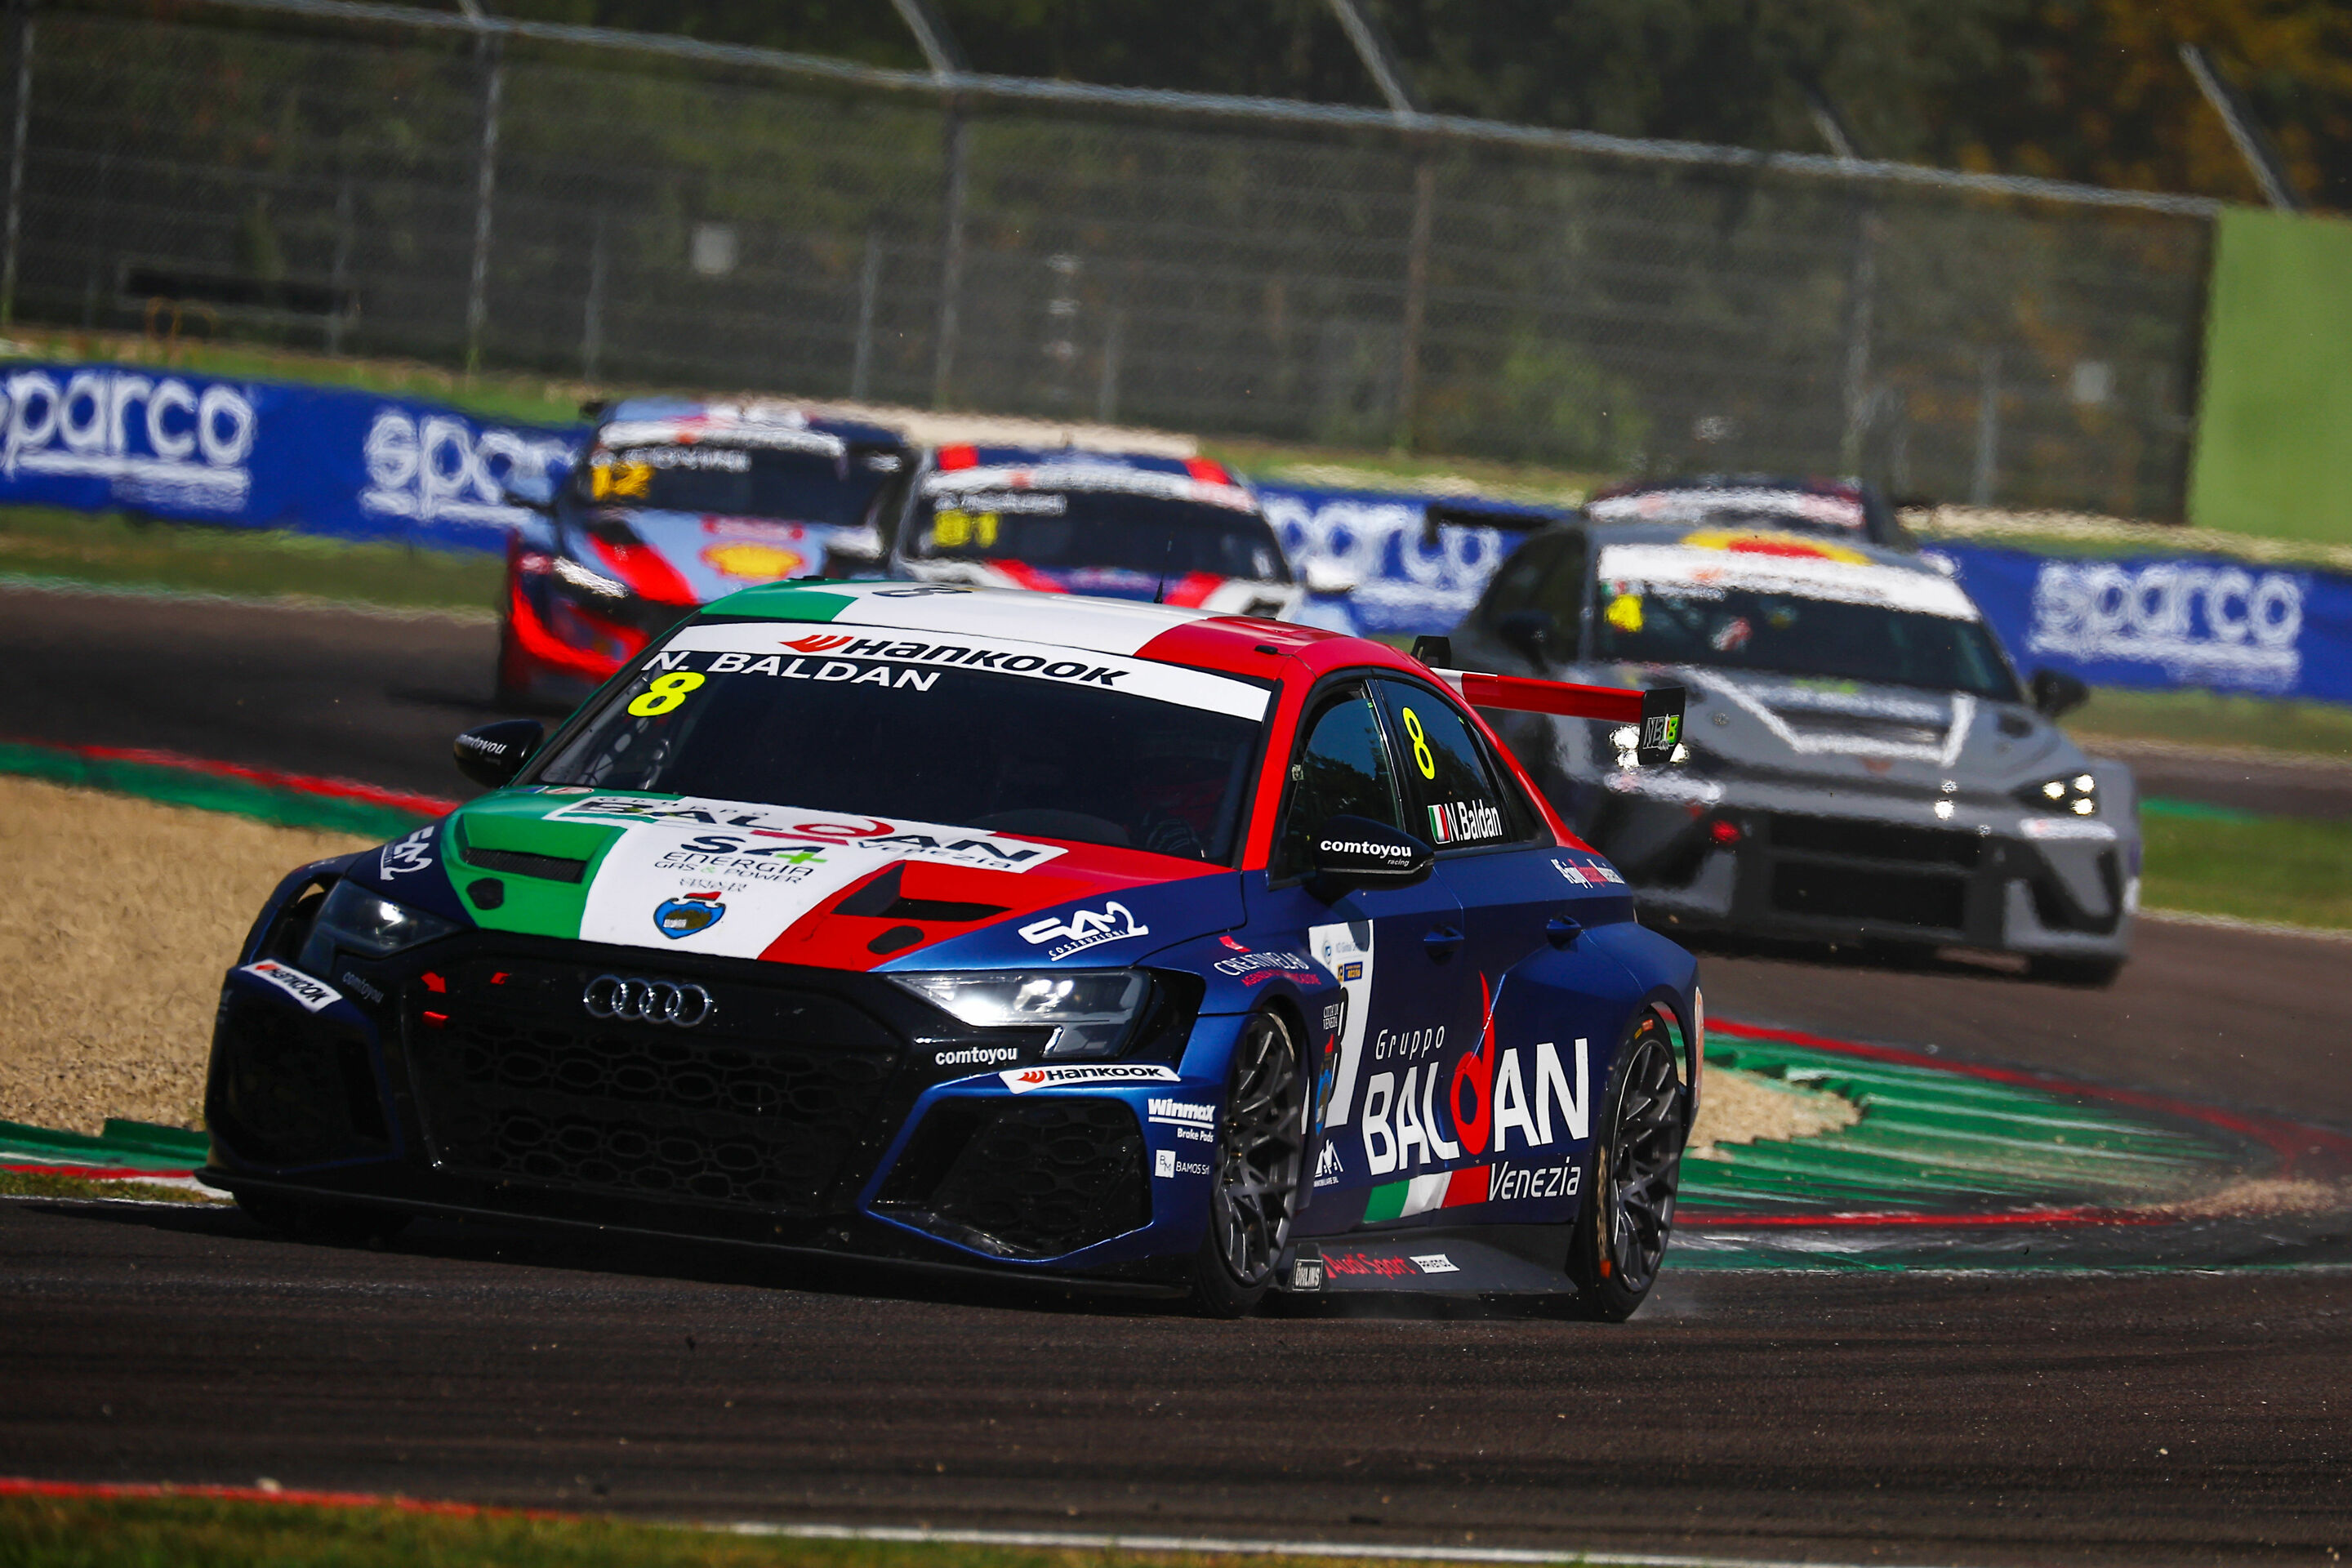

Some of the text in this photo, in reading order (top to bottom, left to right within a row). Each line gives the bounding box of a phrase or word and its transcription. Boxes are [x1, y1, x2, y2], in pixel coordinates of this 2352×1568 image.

[0, 370, 256, 480] parco
[1258, 492, 1503, 591] parco
[2032, 559, 2305, 663] sparco
[641, 652, 942, 692] N. BALDAN
[627, 672, 706, 717] 8
[1402, 707, 1435, 780] 8
[1321, 840, 1412, 858] comtoyou
[1388, 858, 1410, 867] racing
[654, 862, 698, 871] GAS
[724, 868, 802, 884] POWER
[1049, 929, 1126, 957] COSTRUZIONI
[935, 1046, 1018, 1066] comtoyou
[1375, 1025, 1445, 1061] Gruppo
[1177, 1127, 1214, 1143] Brake Pads
[1176, 1160, 1201, 1174] BAMOS
